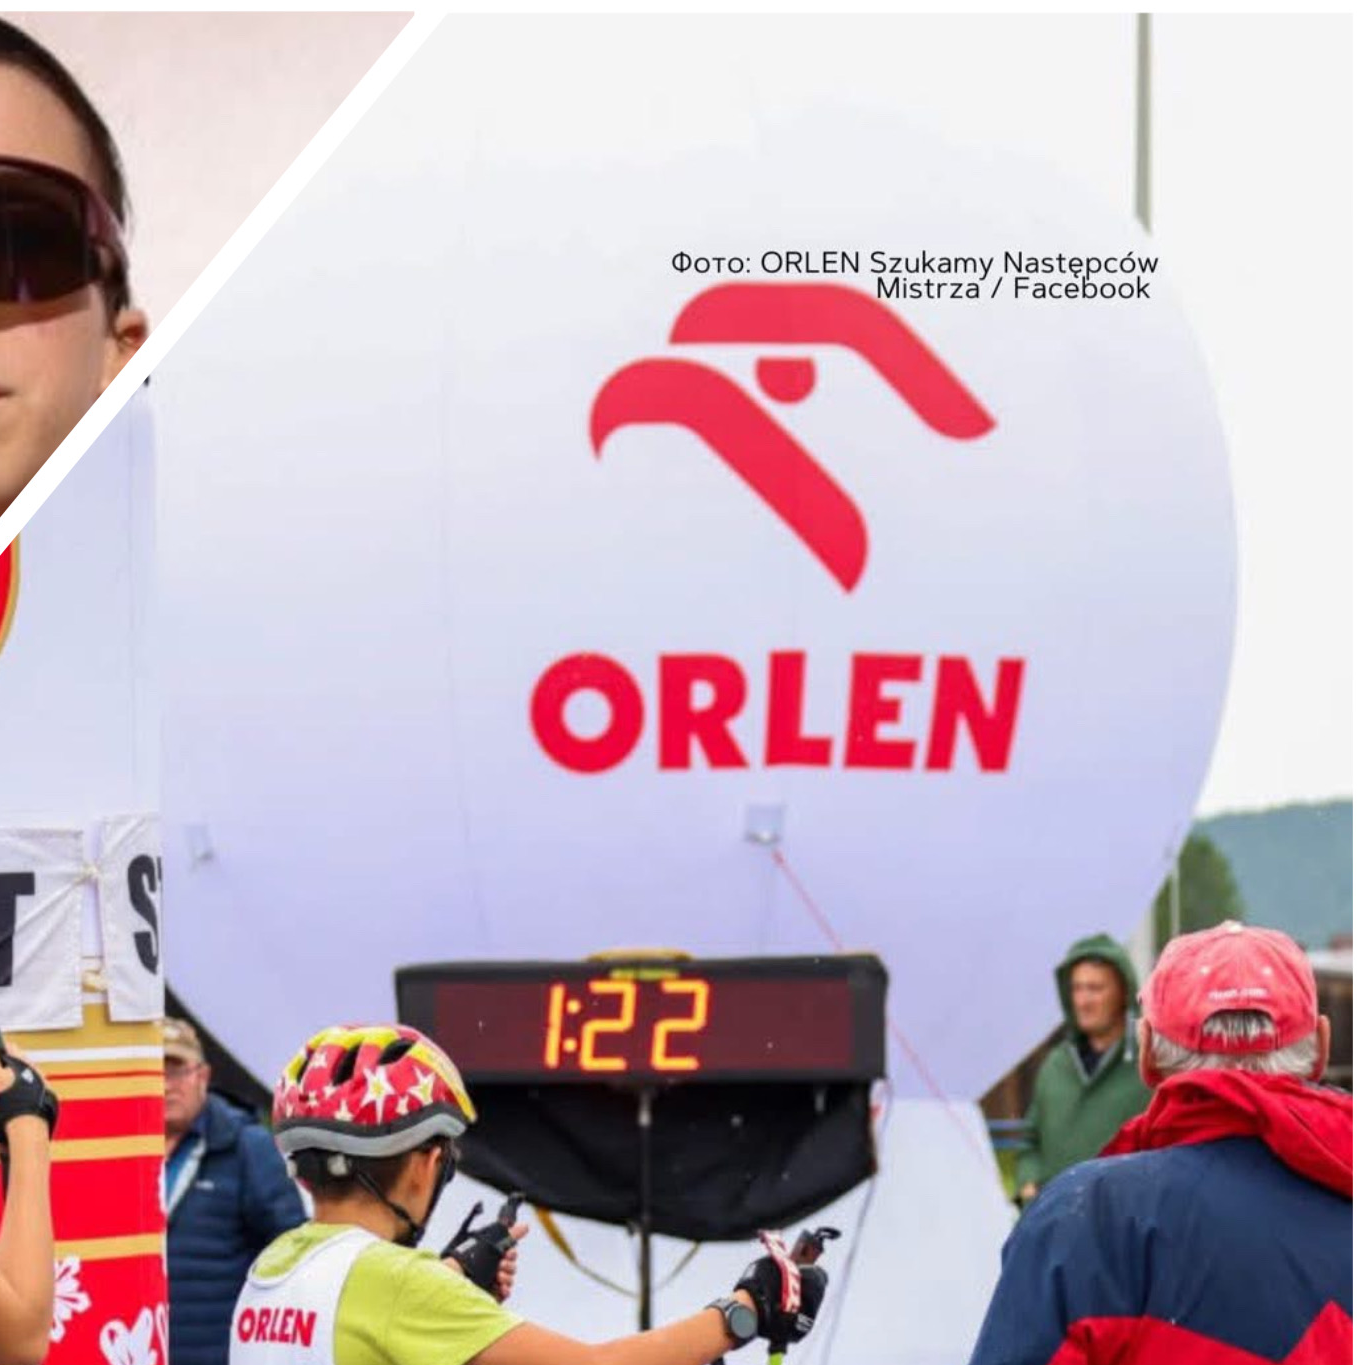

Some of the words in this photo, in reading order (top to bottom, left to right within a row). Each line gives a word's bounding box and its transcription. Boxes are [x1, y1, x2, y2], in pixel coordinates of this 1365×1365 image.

[529, 650, 1026, 775] ORLEN
[543, 979, 710, 1071] 1:22
[237, 1307, 317, 1348] ORLEN
